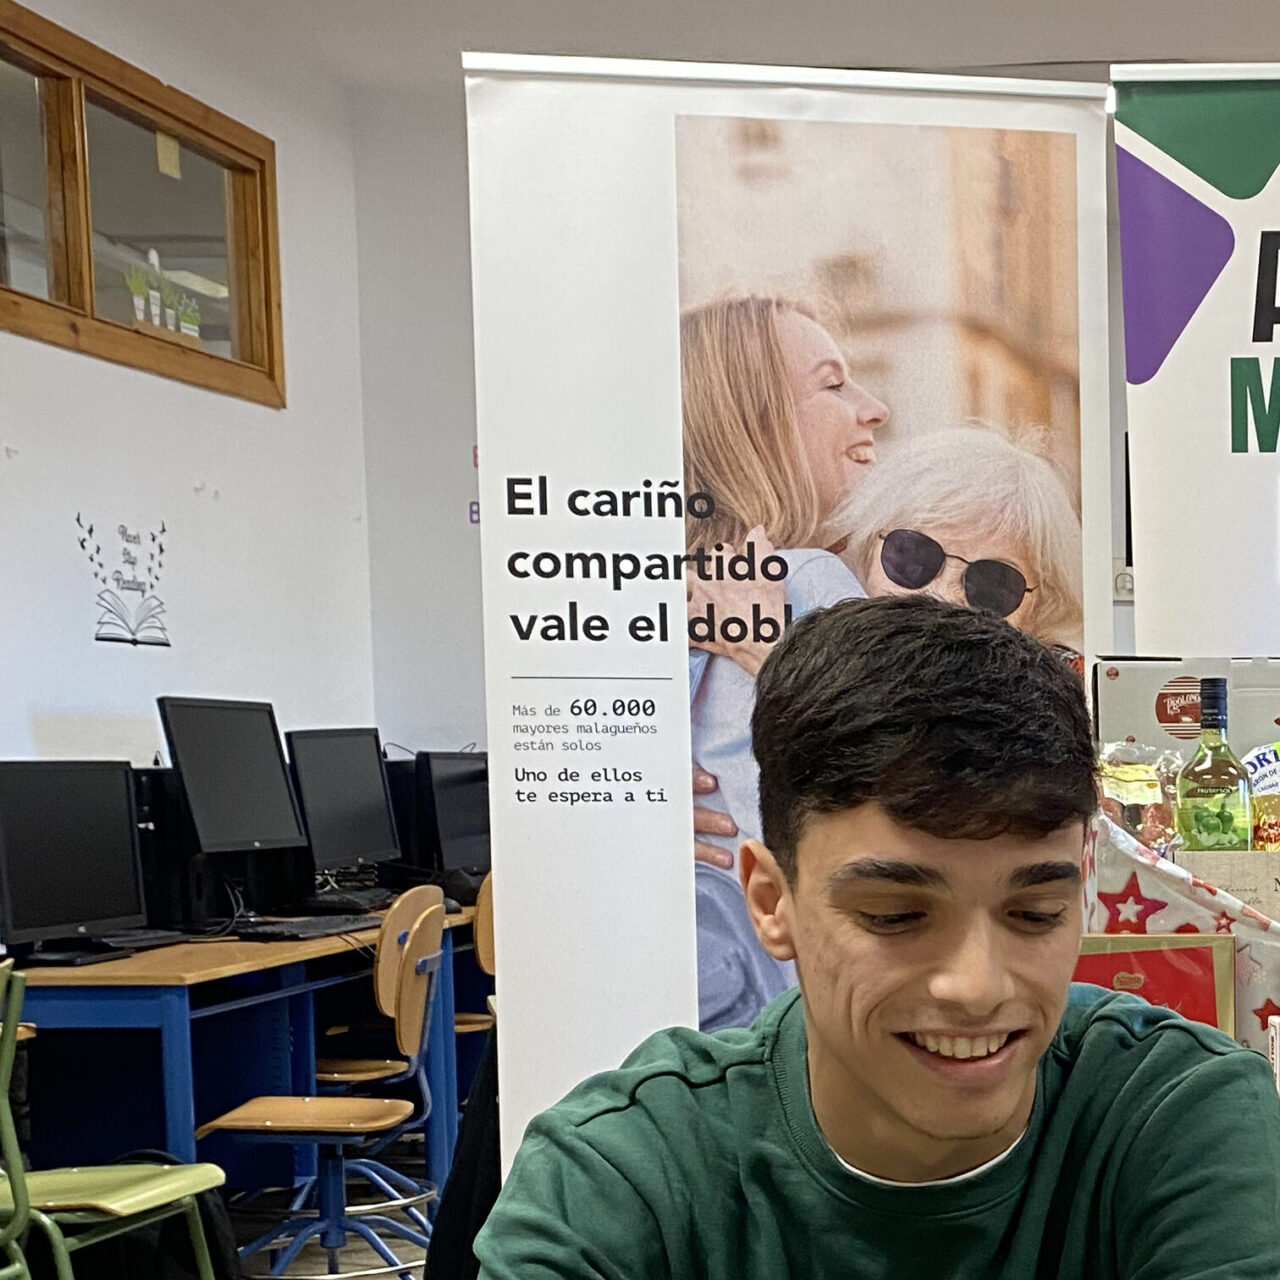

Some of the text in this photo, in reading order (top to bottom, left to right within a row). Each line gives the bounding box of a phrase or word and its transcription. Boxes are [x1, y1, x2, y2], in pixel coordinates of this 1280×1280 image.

[506, 476, 716, 519] El cariño
[507, 541, 789, 591] compartido
[510, 602, 792, 643] vale el dobl
[512, 699, 656, 716] Más de 60.000
[513, 722, 658, 736] mayores malagueños
[514, 740, 602, 751] están solos
[515, 768, 643, 782] Uno de ellos
[515, 788, 668, 806] te espera a ti
